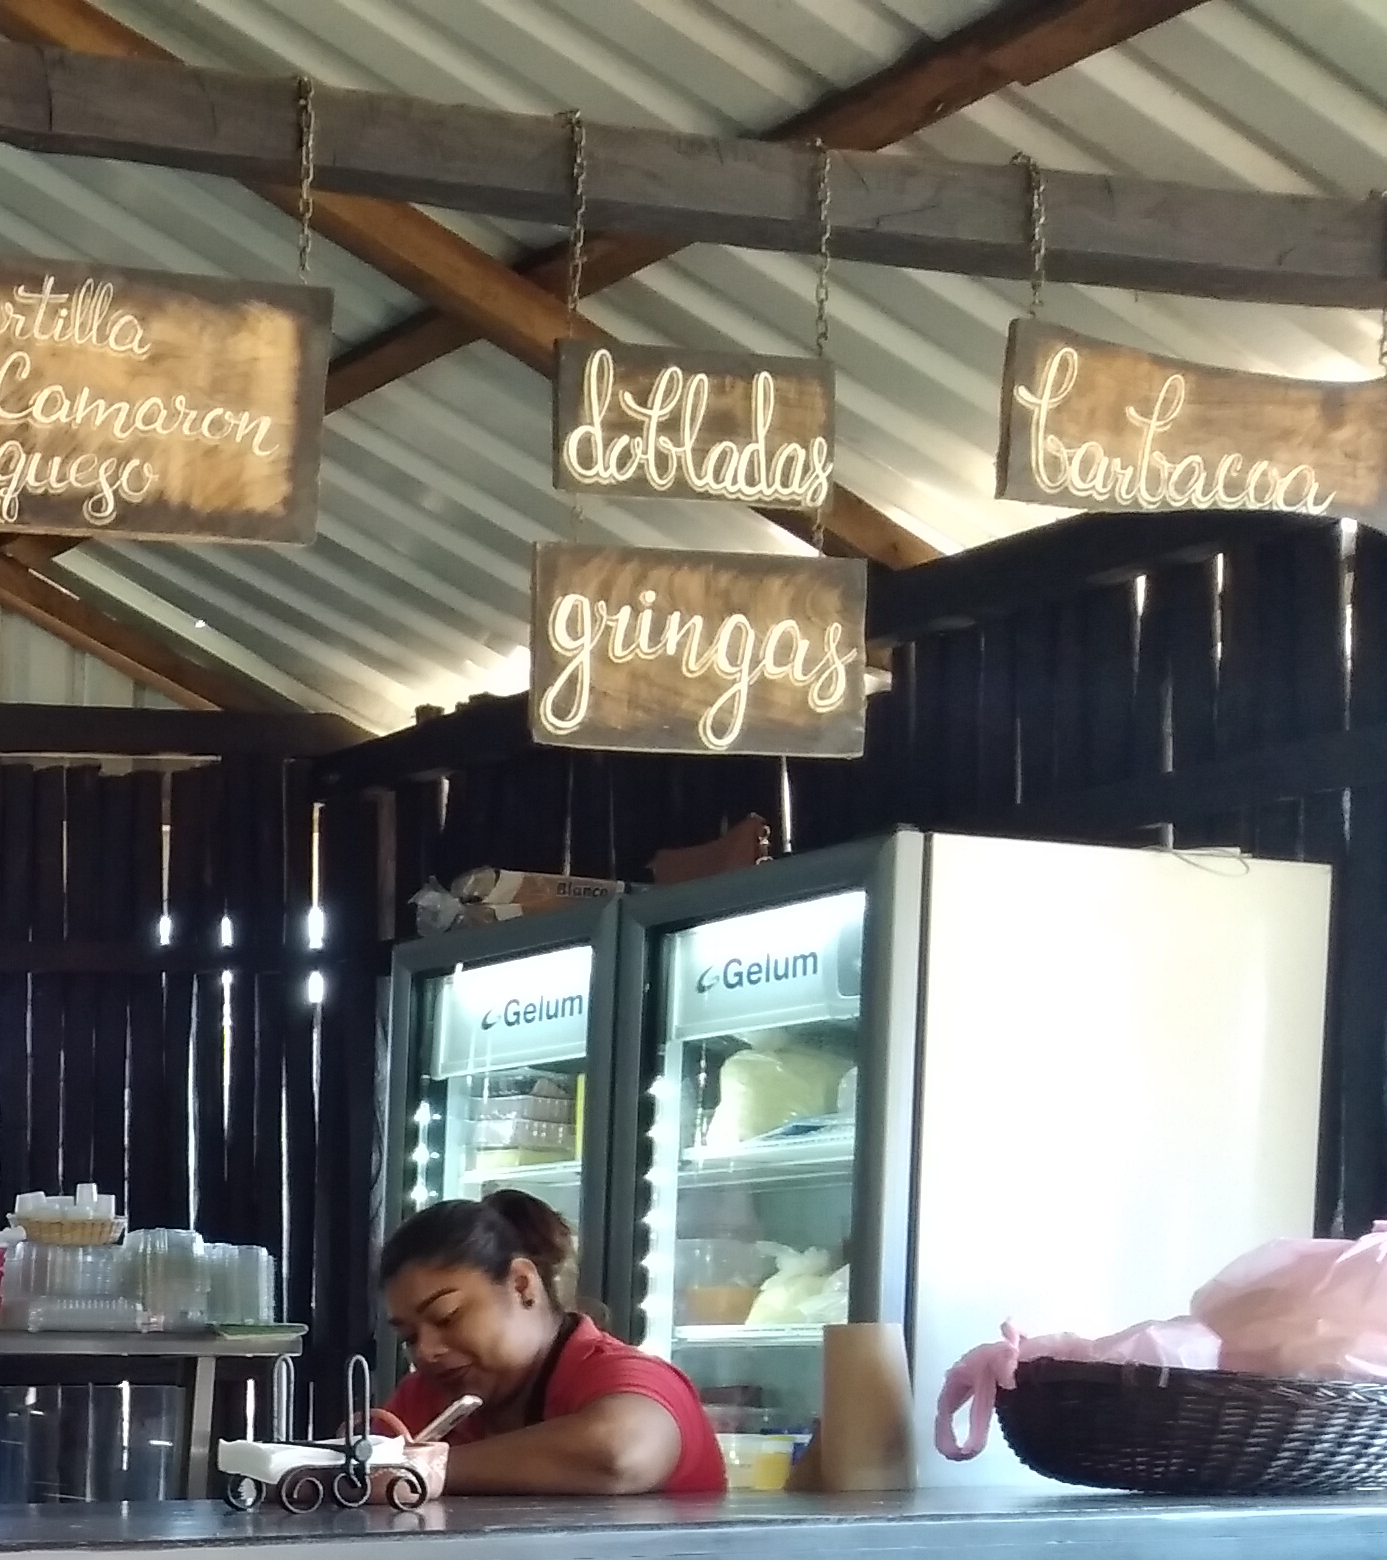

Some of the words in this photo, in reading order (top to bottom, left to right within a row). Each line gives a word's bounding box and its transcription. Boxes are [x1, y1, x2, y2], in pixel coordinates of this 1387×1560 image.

[564, 349, 833, 507] dobladas
[1014, 347, 1337, 514] barbacoa
[540, 590, 857, 751] gringas
[503, 995, 584, 1027] Gelum
[723, 952, 819, 990] Gelum
